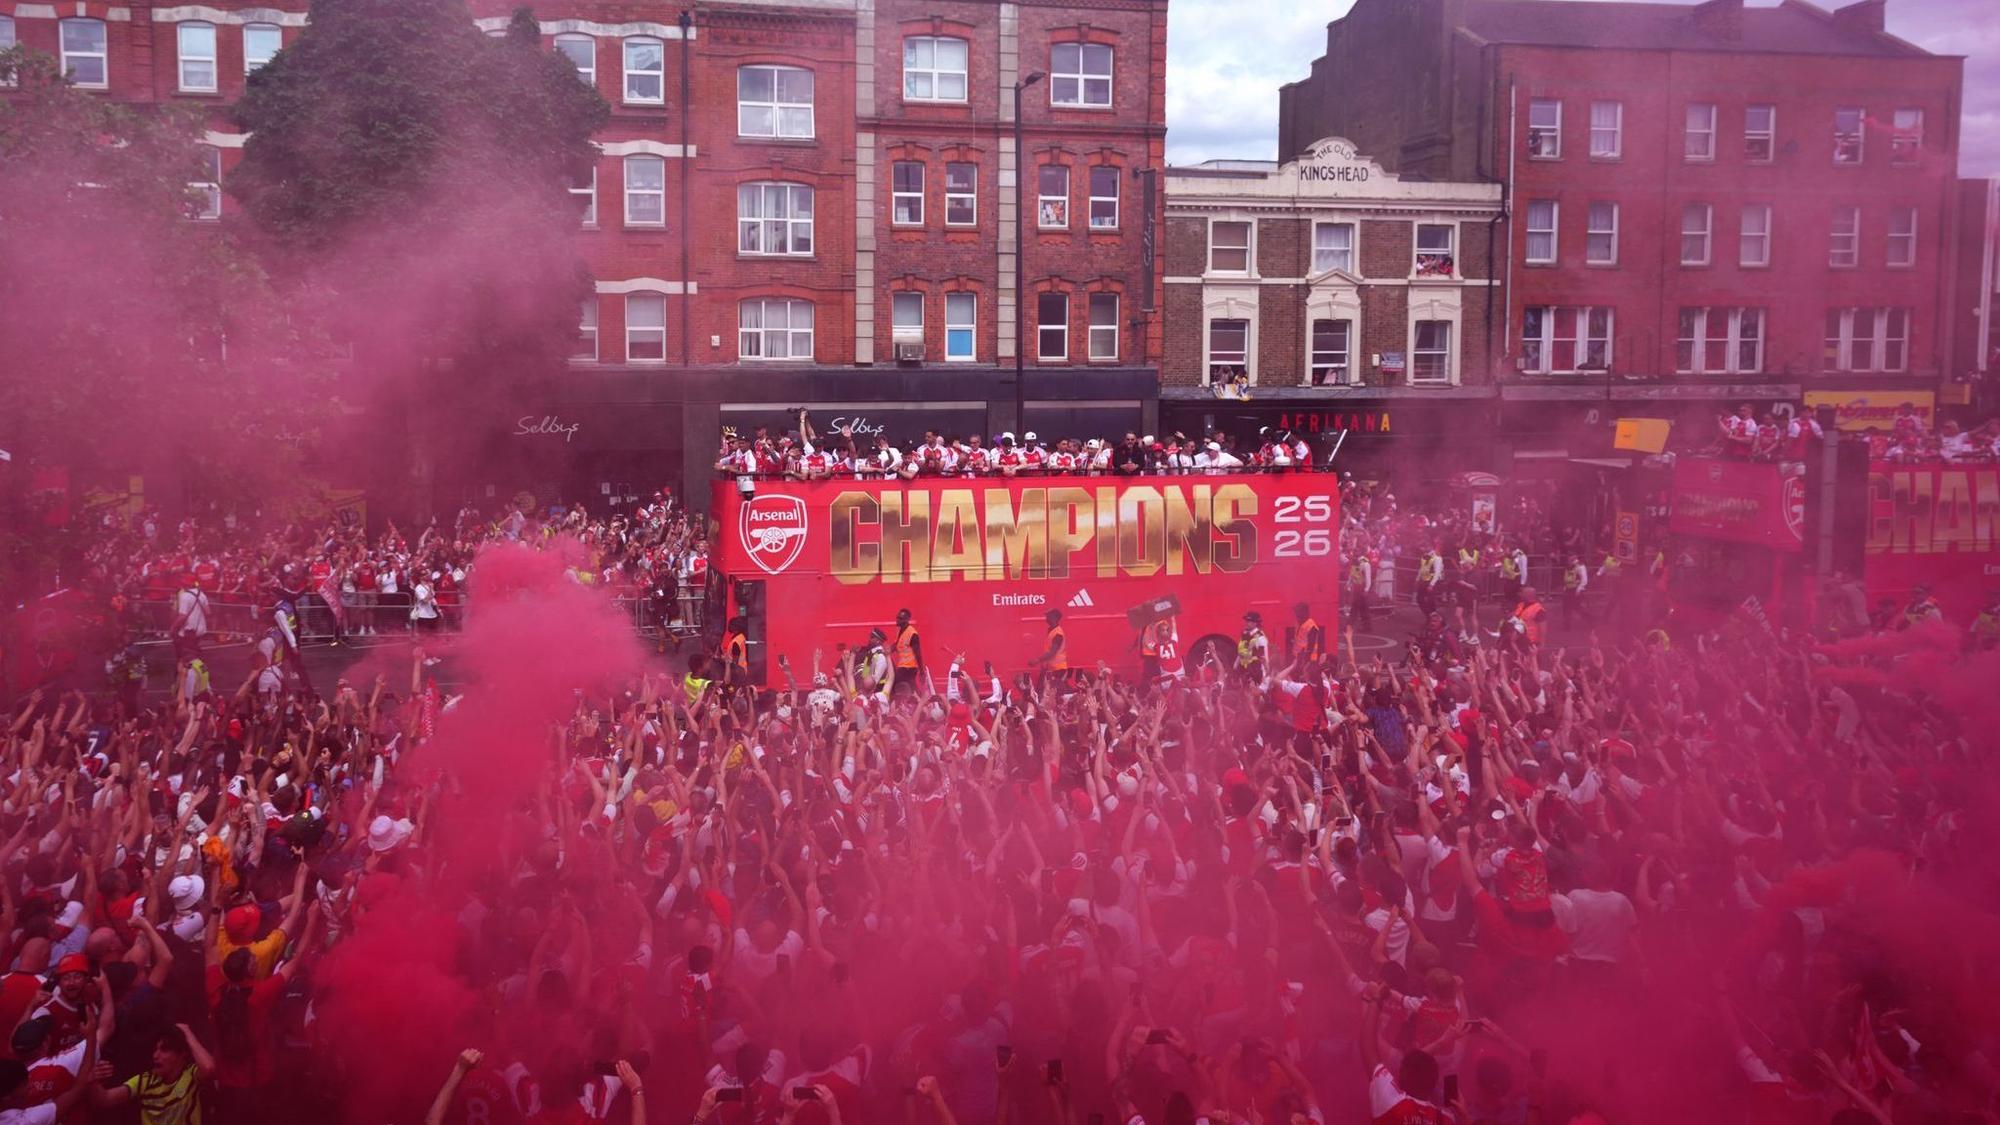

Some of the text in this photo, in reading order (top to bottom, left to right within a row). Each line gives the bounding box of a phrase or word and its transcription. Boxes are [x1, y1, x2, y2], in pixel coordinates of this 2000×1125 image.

[1317, 144, 1352, 160] THE OLD
[1300, 166, 1369, 182] KINGS HEAD
[513, 415, 580, 442] Selbys
[827, 417, 885, 437] Slbys
[1280, 412, 1391, 432] AFRIKANA
[749, 508, 798, 522] Arsenal
[1274, 495, 1331, 523] 25
[829, 483, 1258, 584] CHAMPIONS
[1274, 529, 1331, 557] 26
[992, 593, 1046, 606] Emirates
[1159, 643, 1176, 660] 41
